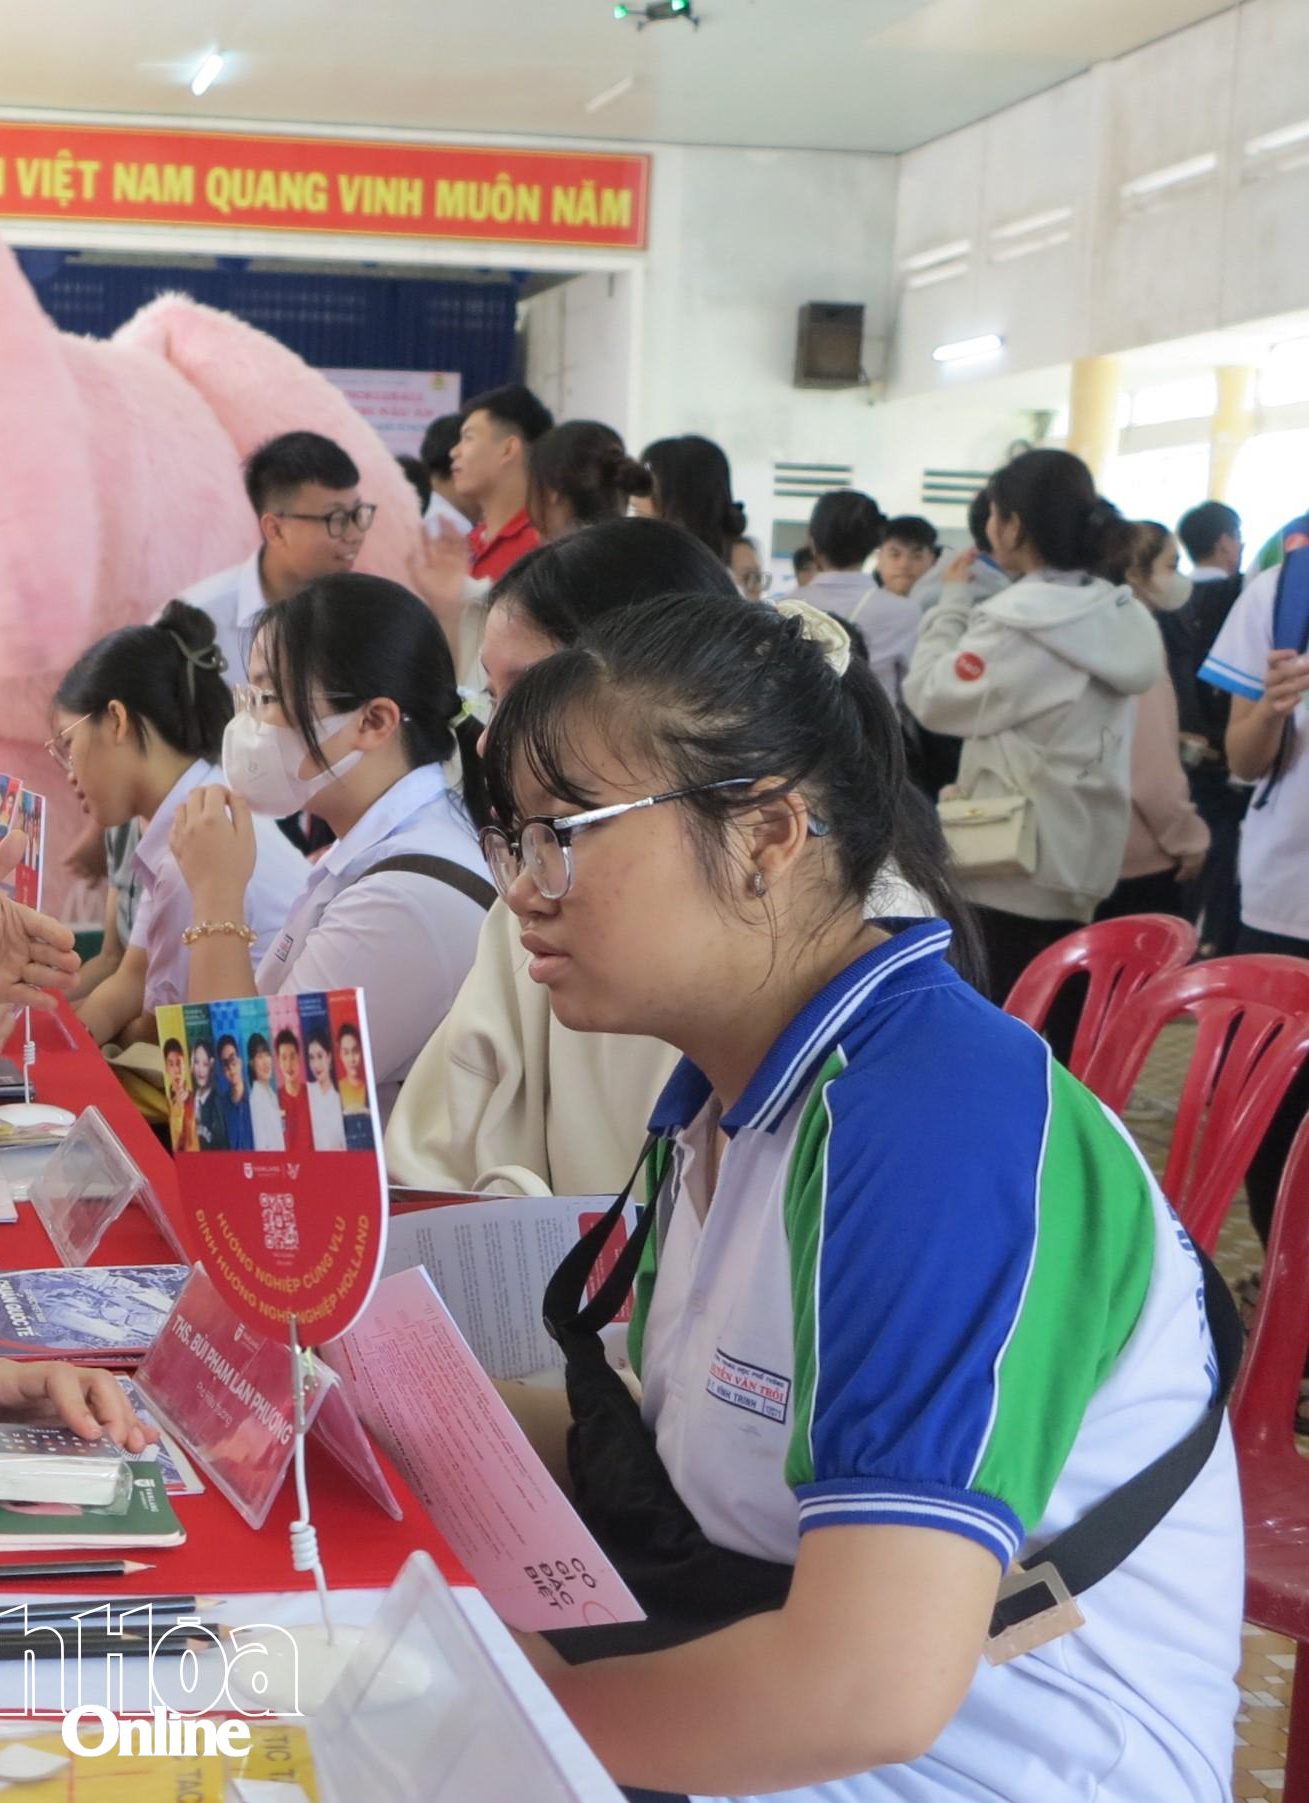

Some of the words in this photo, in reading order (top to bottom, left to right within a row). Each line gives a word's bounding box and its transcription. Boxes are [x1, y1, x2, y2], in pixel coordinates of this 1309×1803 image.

[16, 149, 101, 207] VIỆT
[113, 162, 193, 205] NAM
[205, 166, 328, 214] QUANG
[339, 173, 423, 217] VINH
[435, 171, 542, 223] MUÔN
[552, 179, 633, 228] NĂM
[328, 1216, 346, 1253] VLU
[338, 1215, 370, 1300] HOLLAND
[171, 1314, 192, 1343] THS.
[228, 1370, 258, 1404] LAN
[734, 1374, 757, 1391] VĂN
